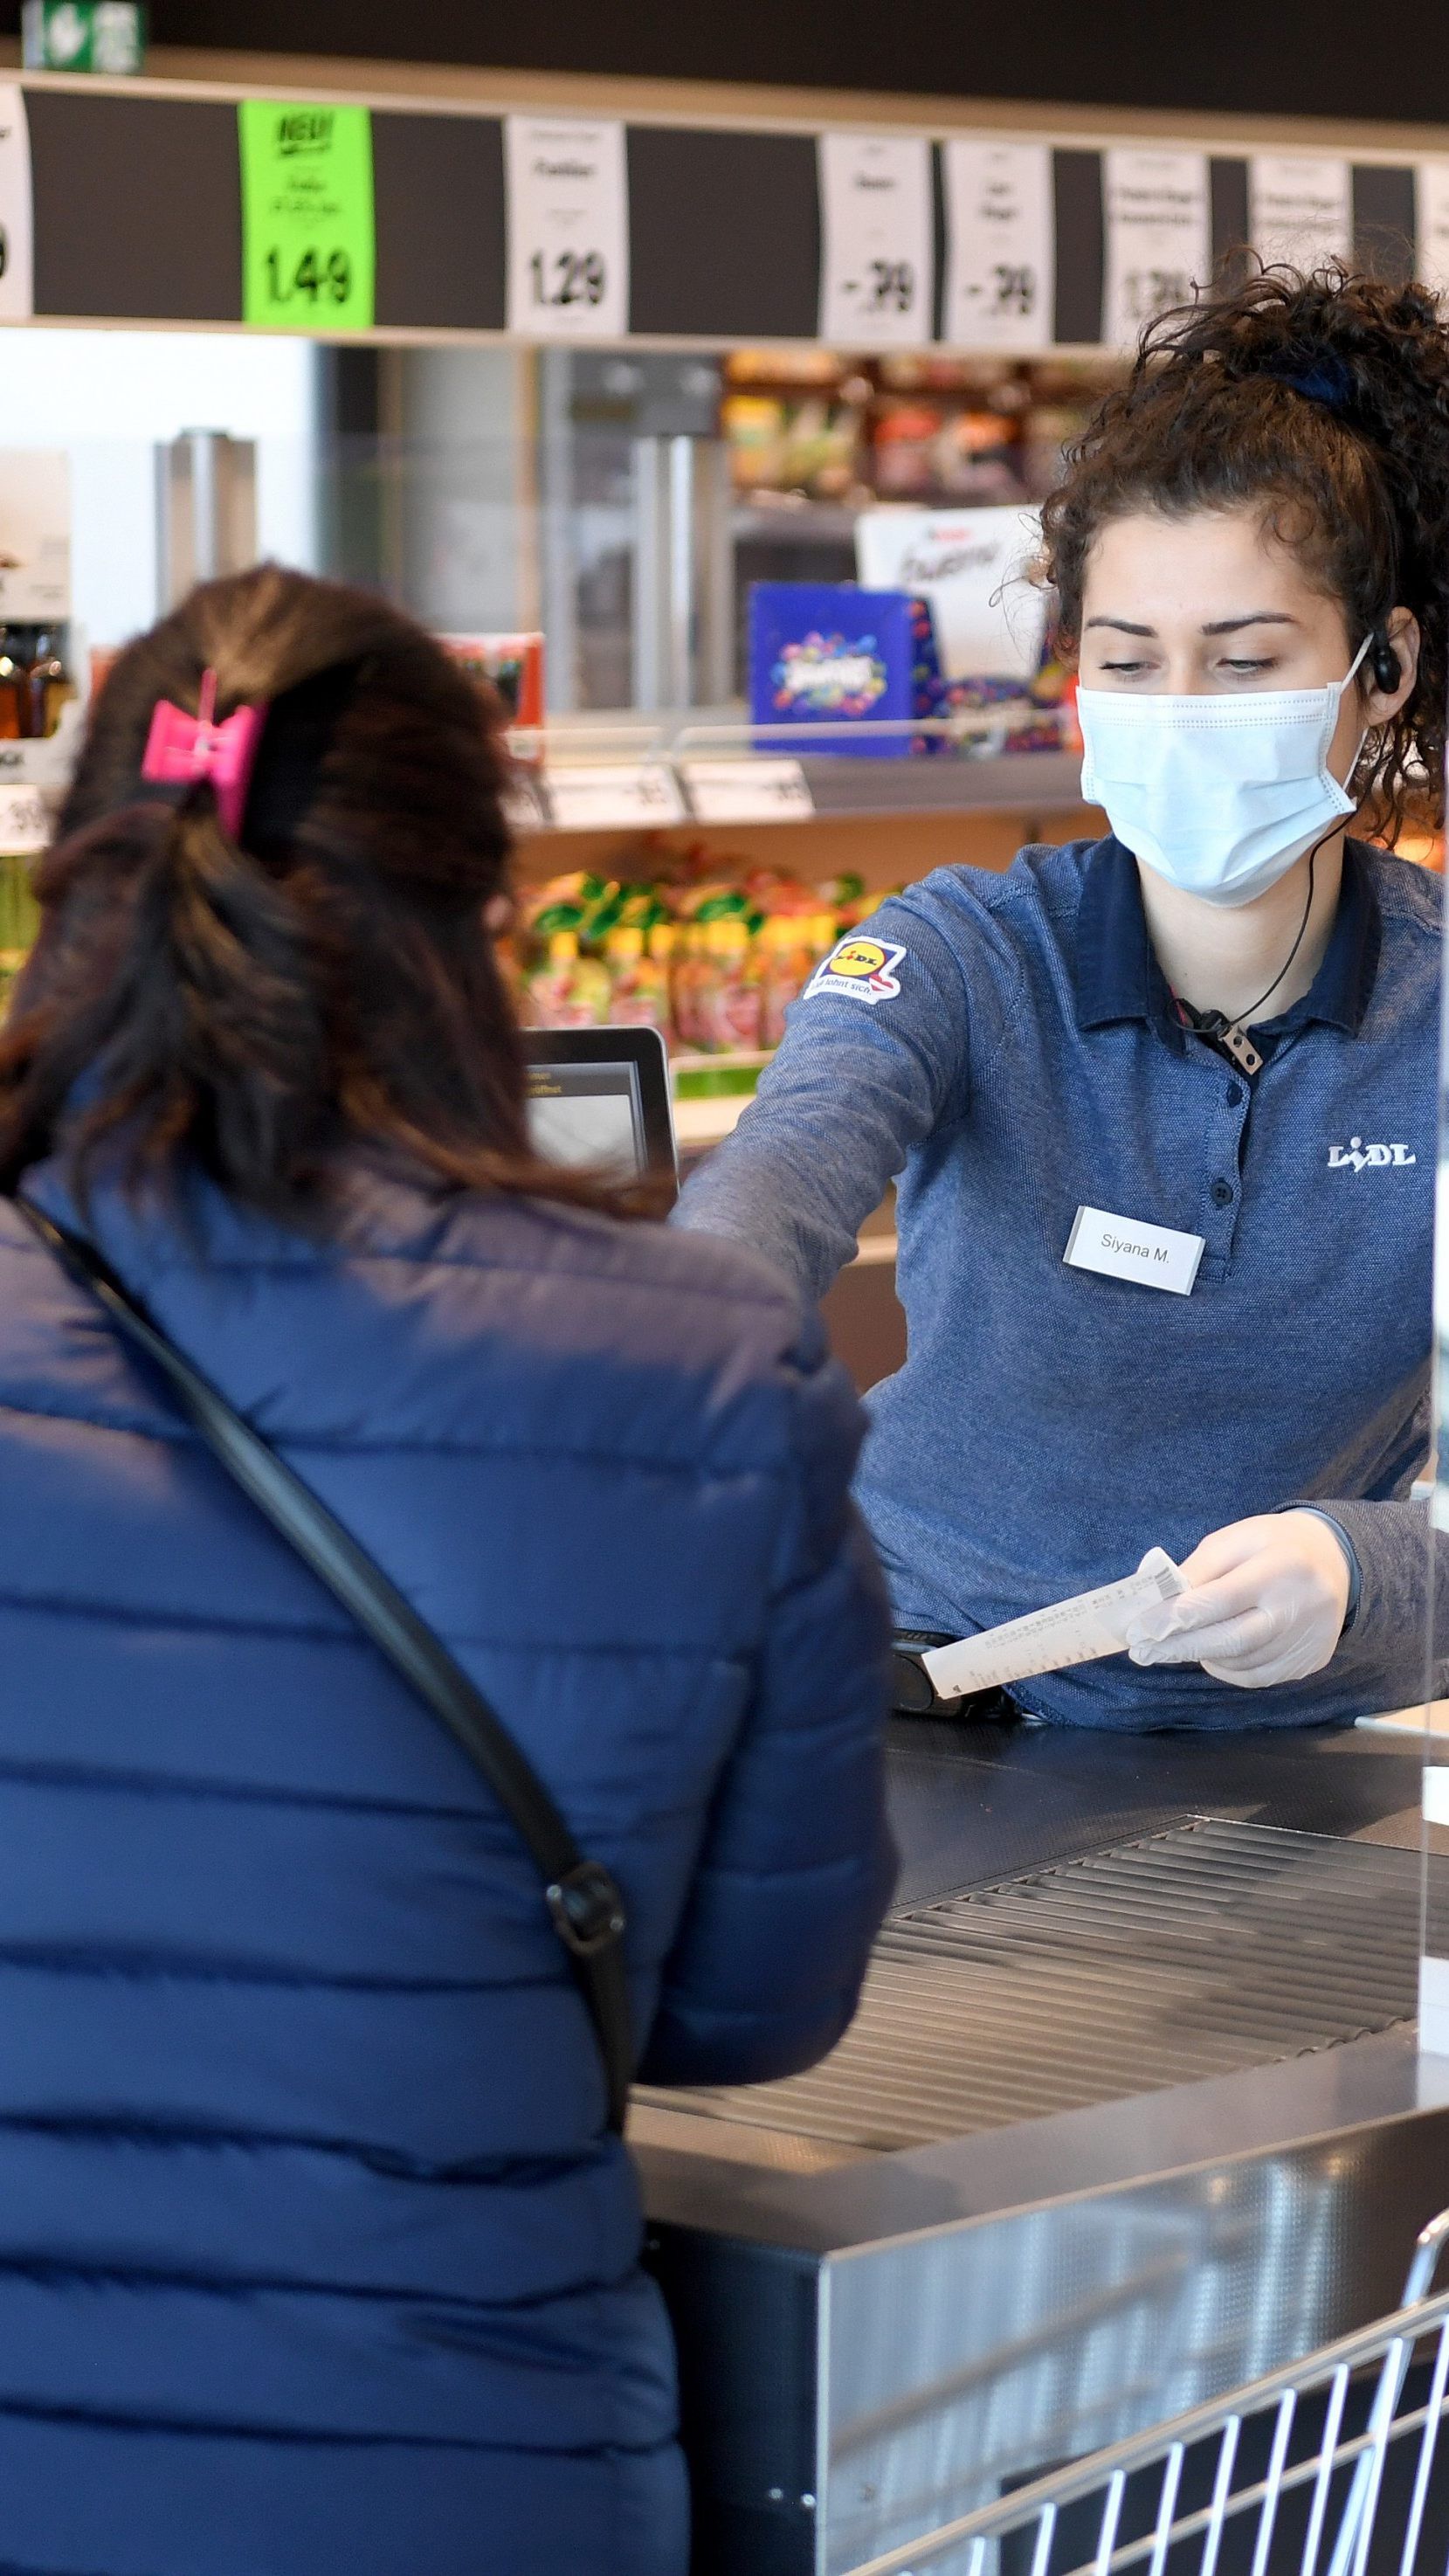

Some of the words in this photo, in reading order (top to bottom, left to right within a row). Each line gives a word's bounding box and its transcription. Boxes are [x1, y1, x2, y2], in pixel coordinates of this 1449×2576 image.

[266, 245, 351, 303] 1.49
[530, 248, 606, 307] 1.29
[825, 978, 848, 988] lohnt
[851, 984, 872, 995] sich.
[1101, 1233, 1149, 1258] Siyana
[1154, 1247, 1170, 1264] M.
